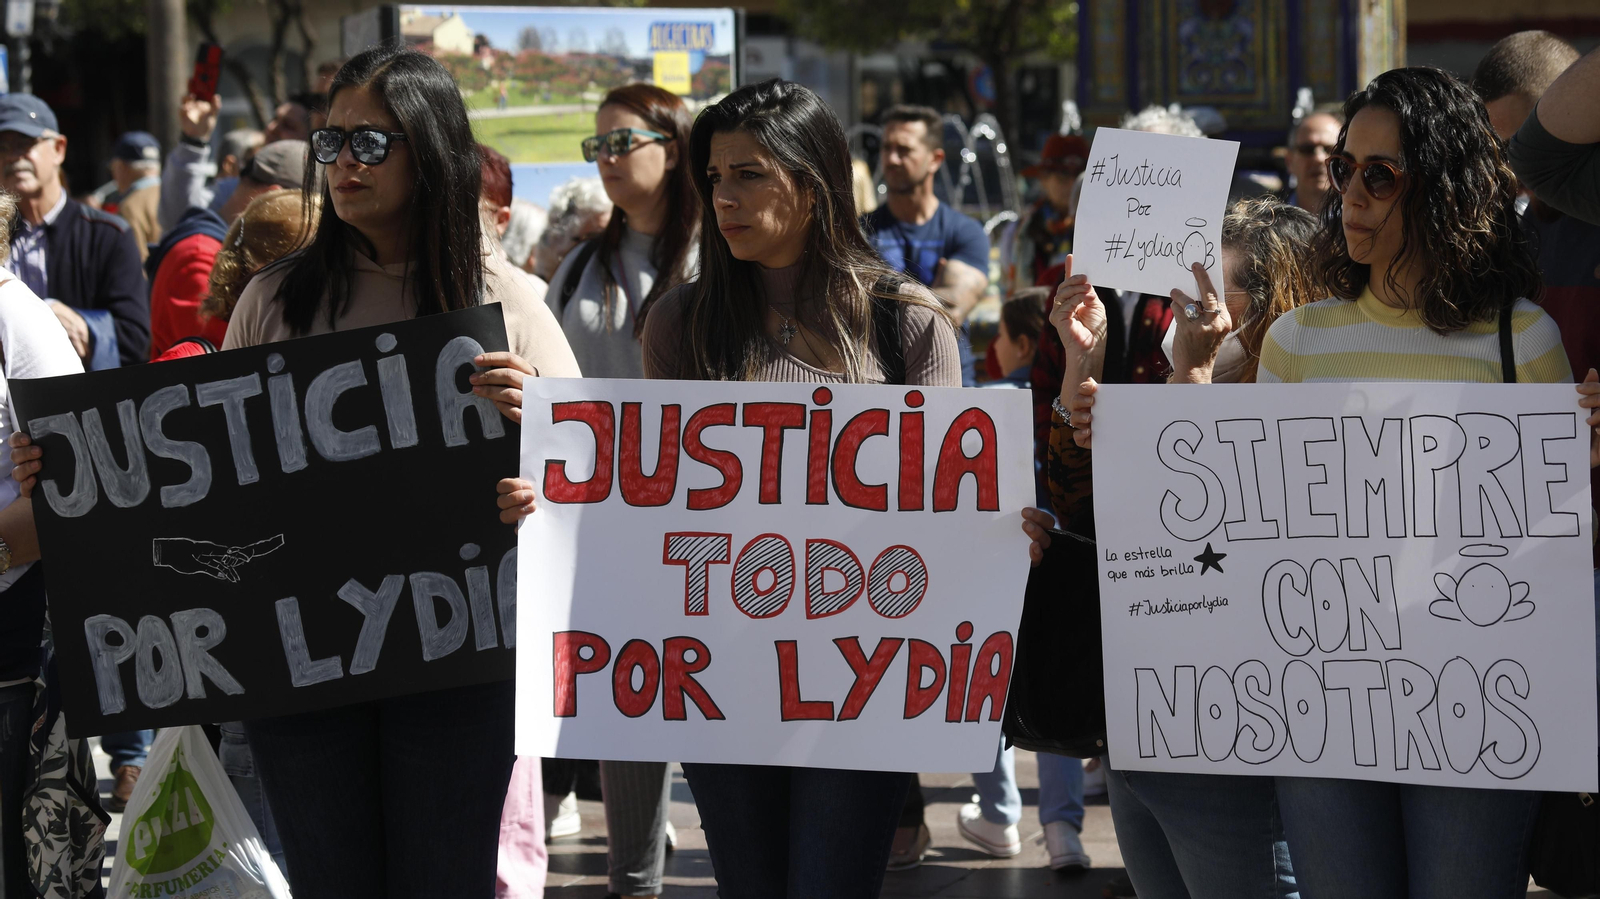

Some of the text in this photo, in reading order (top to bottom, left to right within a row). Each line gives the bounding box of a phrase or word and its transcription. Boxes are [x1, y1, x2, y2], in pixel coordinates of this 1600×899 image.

[1090, 153, 1182, 188] #Justicia
[1126, 197, 1152, 218] Por
[1104, 228, 1175, 271] #Lydia
[1156, 412, 1580, 542] SIEMPRE
[662, 531, 929, 620] TODO
[1105, 546, 1172, 562] La estrella
[1107, 562, 1194, 583] que más brilla
[1261, 554, 1402, 657] CON
[84, 607, 246, 716] POR
[552, 630, 726, 722] POR
[1134, 656, 1541, 780] NOSOTROS
